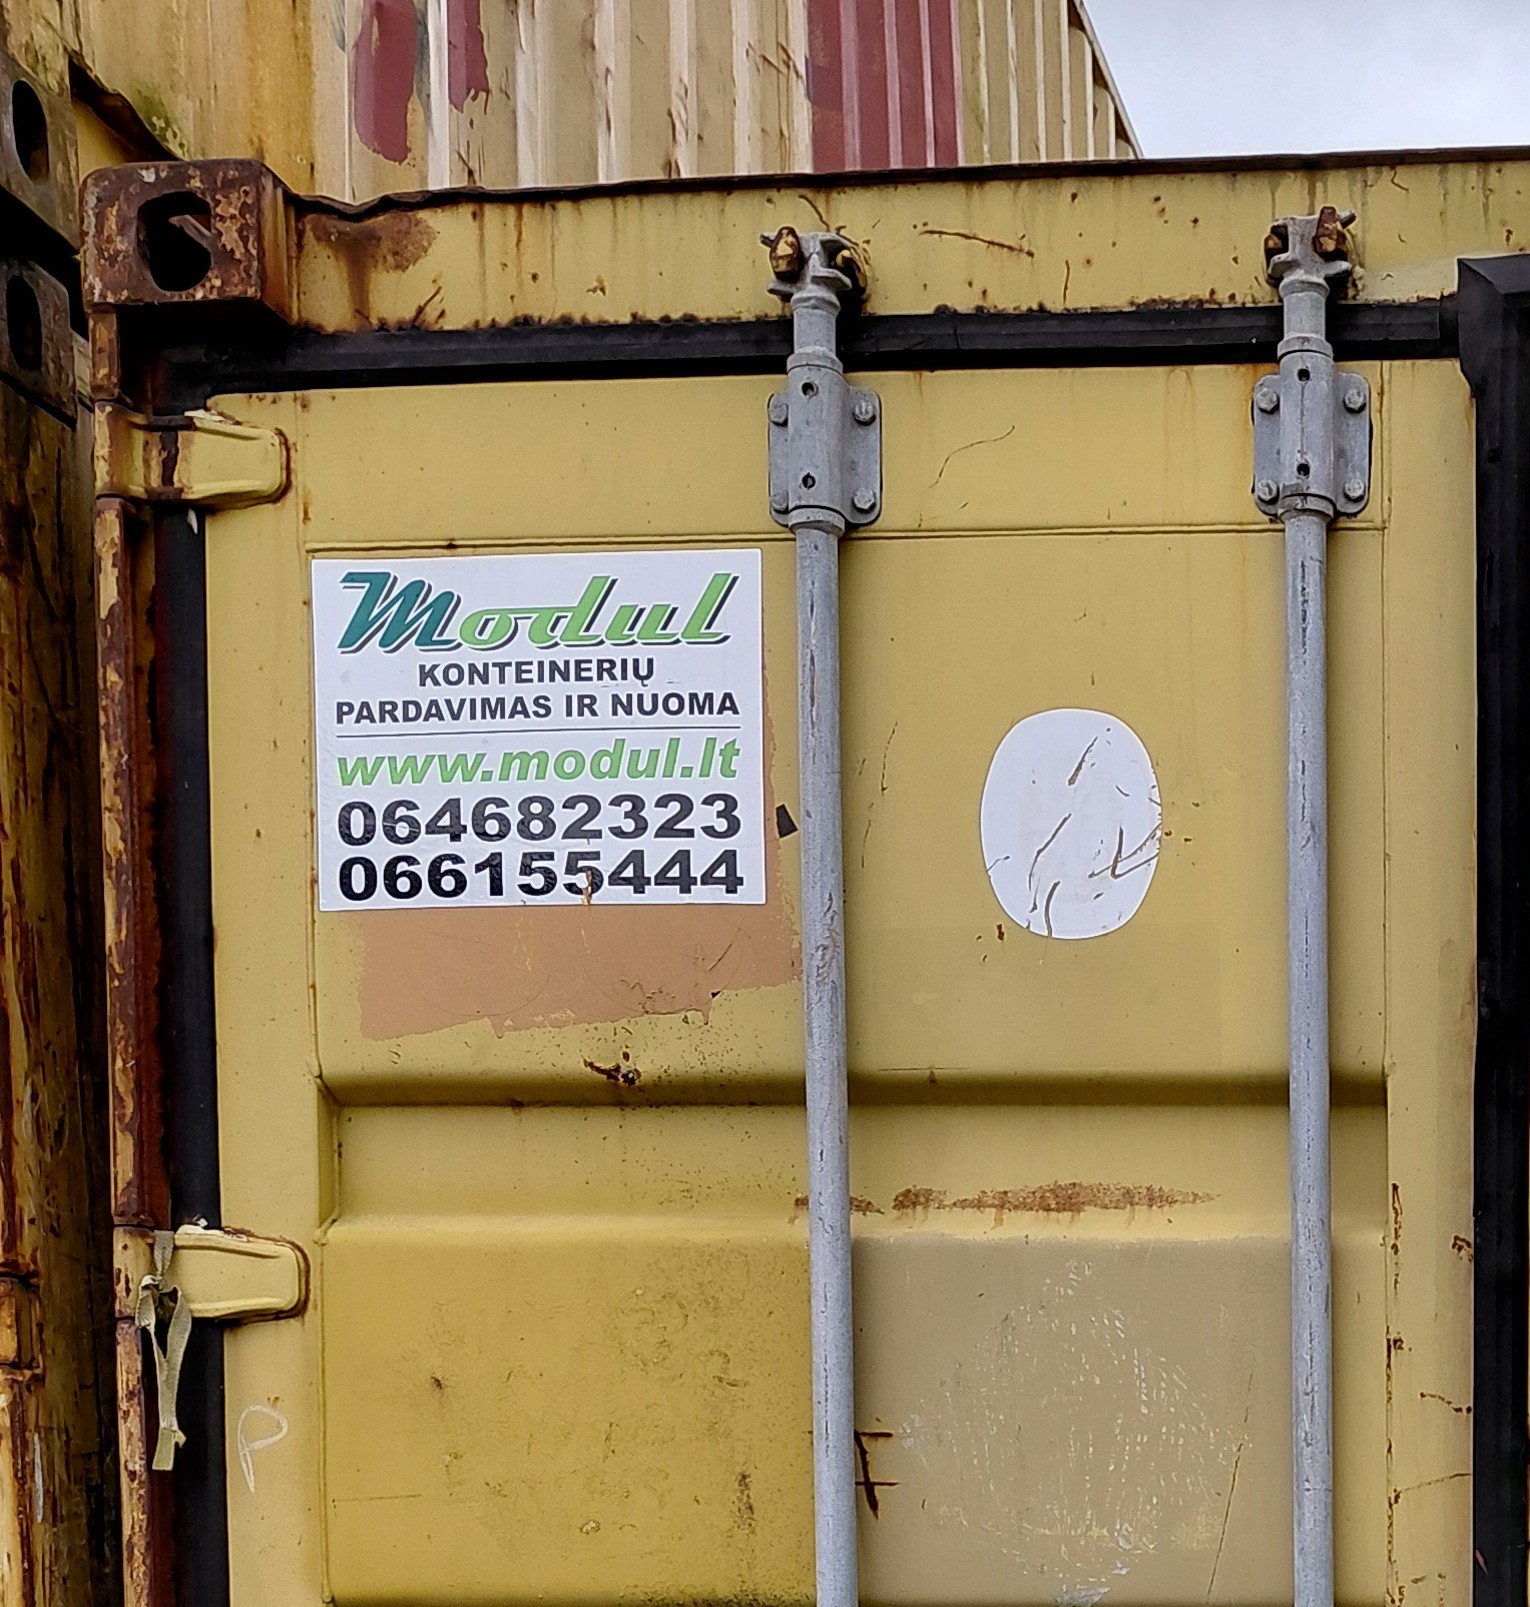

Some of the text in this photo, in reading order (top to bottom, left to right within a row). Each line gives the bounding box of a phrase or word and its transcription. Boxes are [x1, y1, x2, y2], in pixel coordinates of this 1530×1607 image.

[337, 571, 740, 654] Modul
[419, 658, 653, 687] KONTEINERIŲ
[337, 693, 739, 724] PARDAVIMAS IR NUOMA
[338, 737, 741, 786] www.modul.lt
[339, 794, 740, 846] 064682323
[340, 850, 743, 901] 066155444
